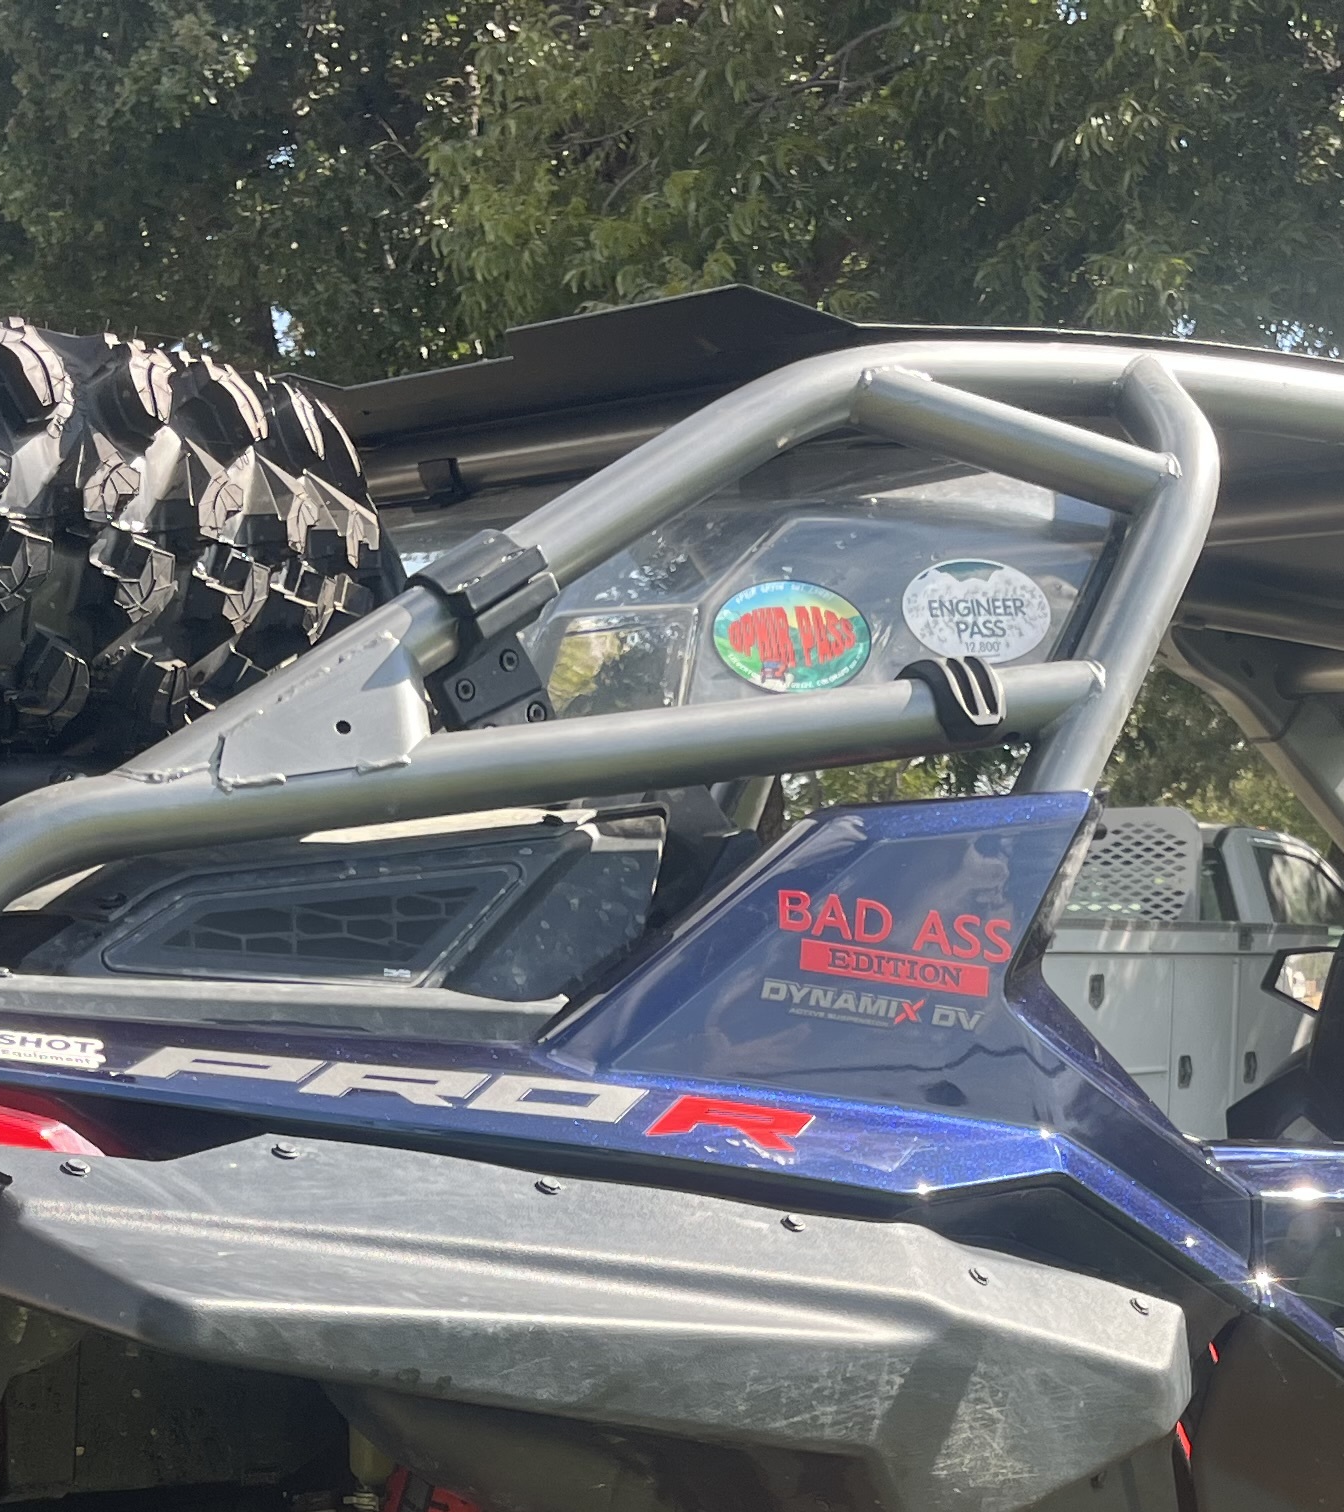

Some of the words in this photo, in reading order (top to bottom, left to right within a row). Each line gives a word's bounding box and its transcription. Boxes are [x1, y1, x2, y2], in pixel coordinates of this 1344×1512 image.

[927, 597, 1027, 618] ENGINEER
[955, 619, 1007, 642] PASS
[794, 605, 856, 668] PASS
[777, 889, 894, 944] BAD
[911, 909, 1013, 964] ASS
[827, 948, 963, 987] EDITION
[760, 977, 927, 1025] DYNAMIX
[930, 1004, 987, 1031] DV
[0, 1048, 91, 1065] Equipment
[120, 1045, 651, 1124] PRO
[645, 1094, 816, 1152] R
